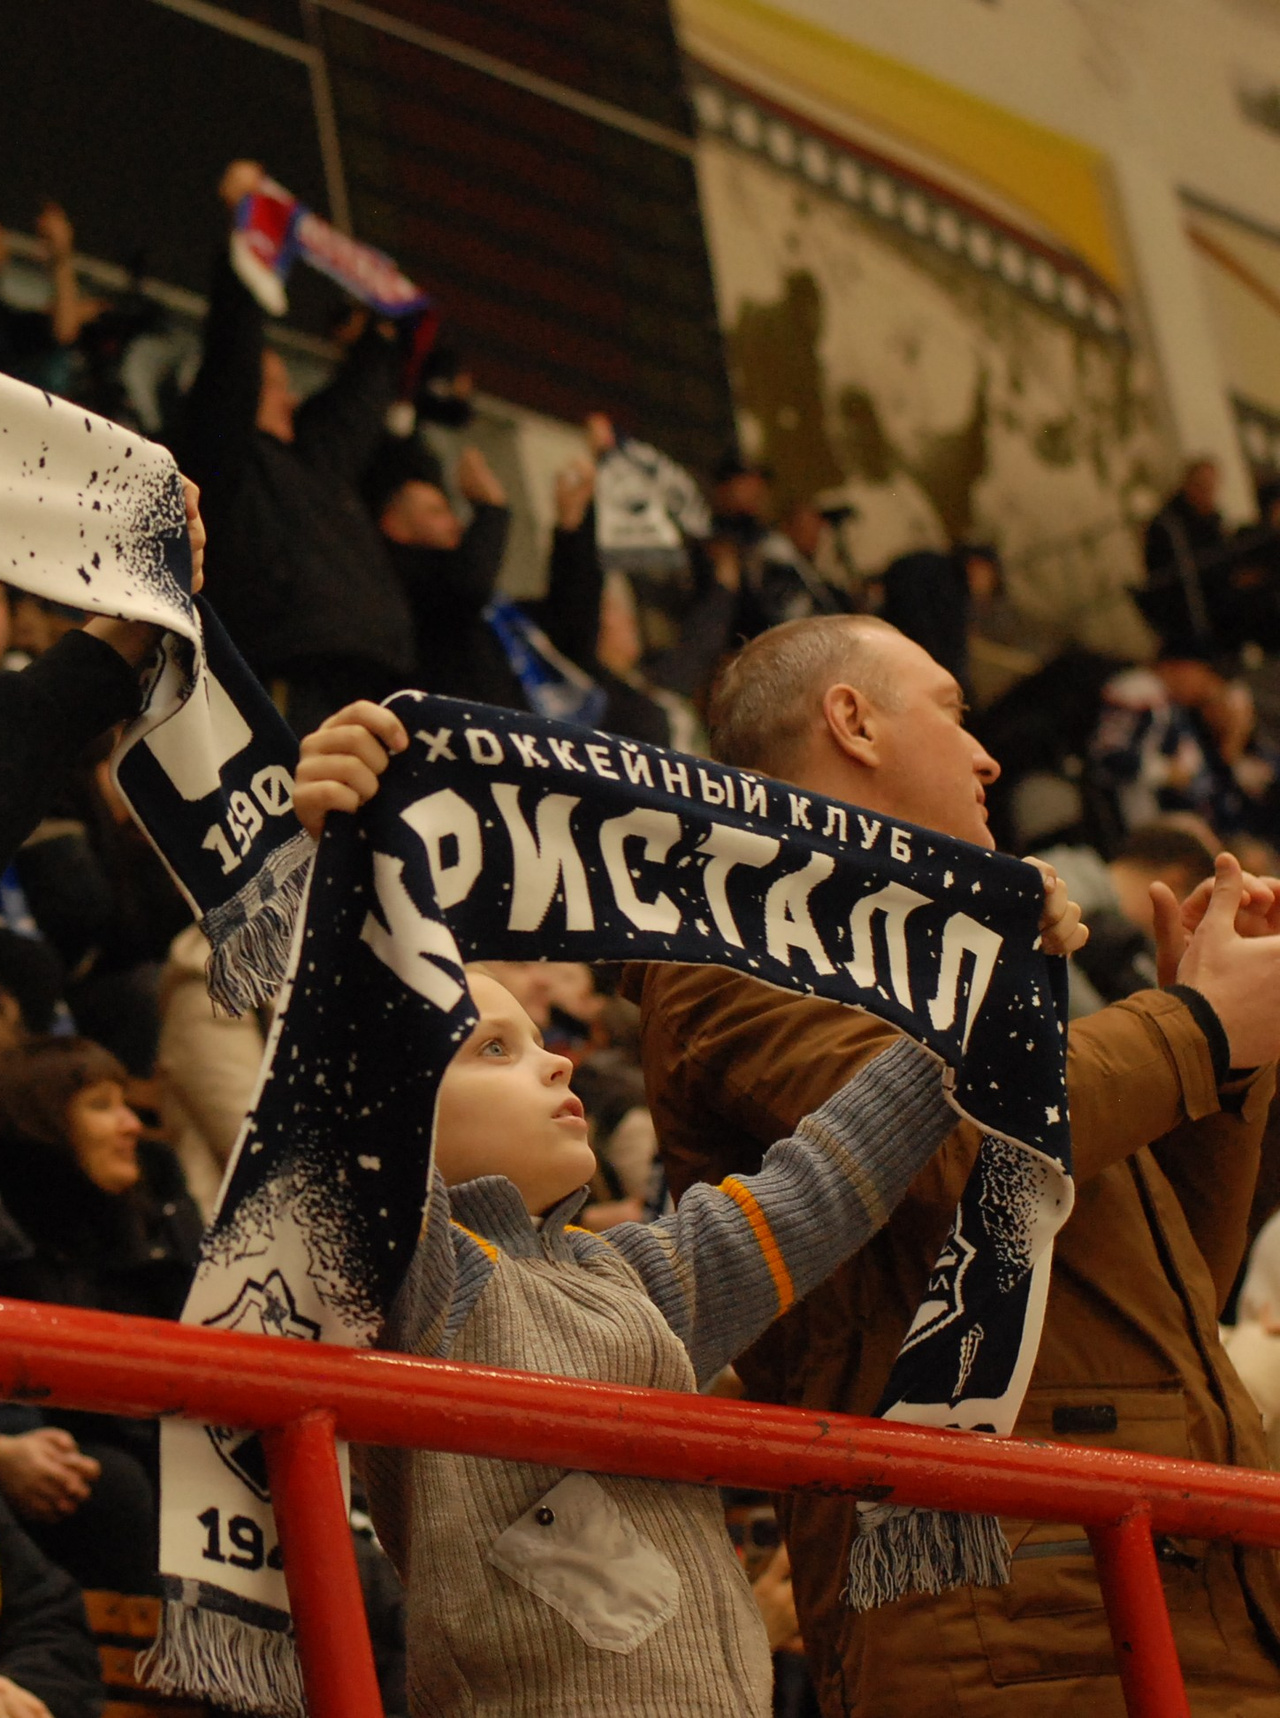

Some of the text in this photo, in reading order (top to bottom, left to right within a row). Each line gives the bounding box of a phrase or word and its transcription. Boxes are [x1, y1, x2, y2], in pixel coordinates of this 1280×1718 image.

[415, 728, 914, 864] ХОККЕЙНЫЙ КЛУБ
[360, 783, 1004, 1055] КРИСТАЛЛ
